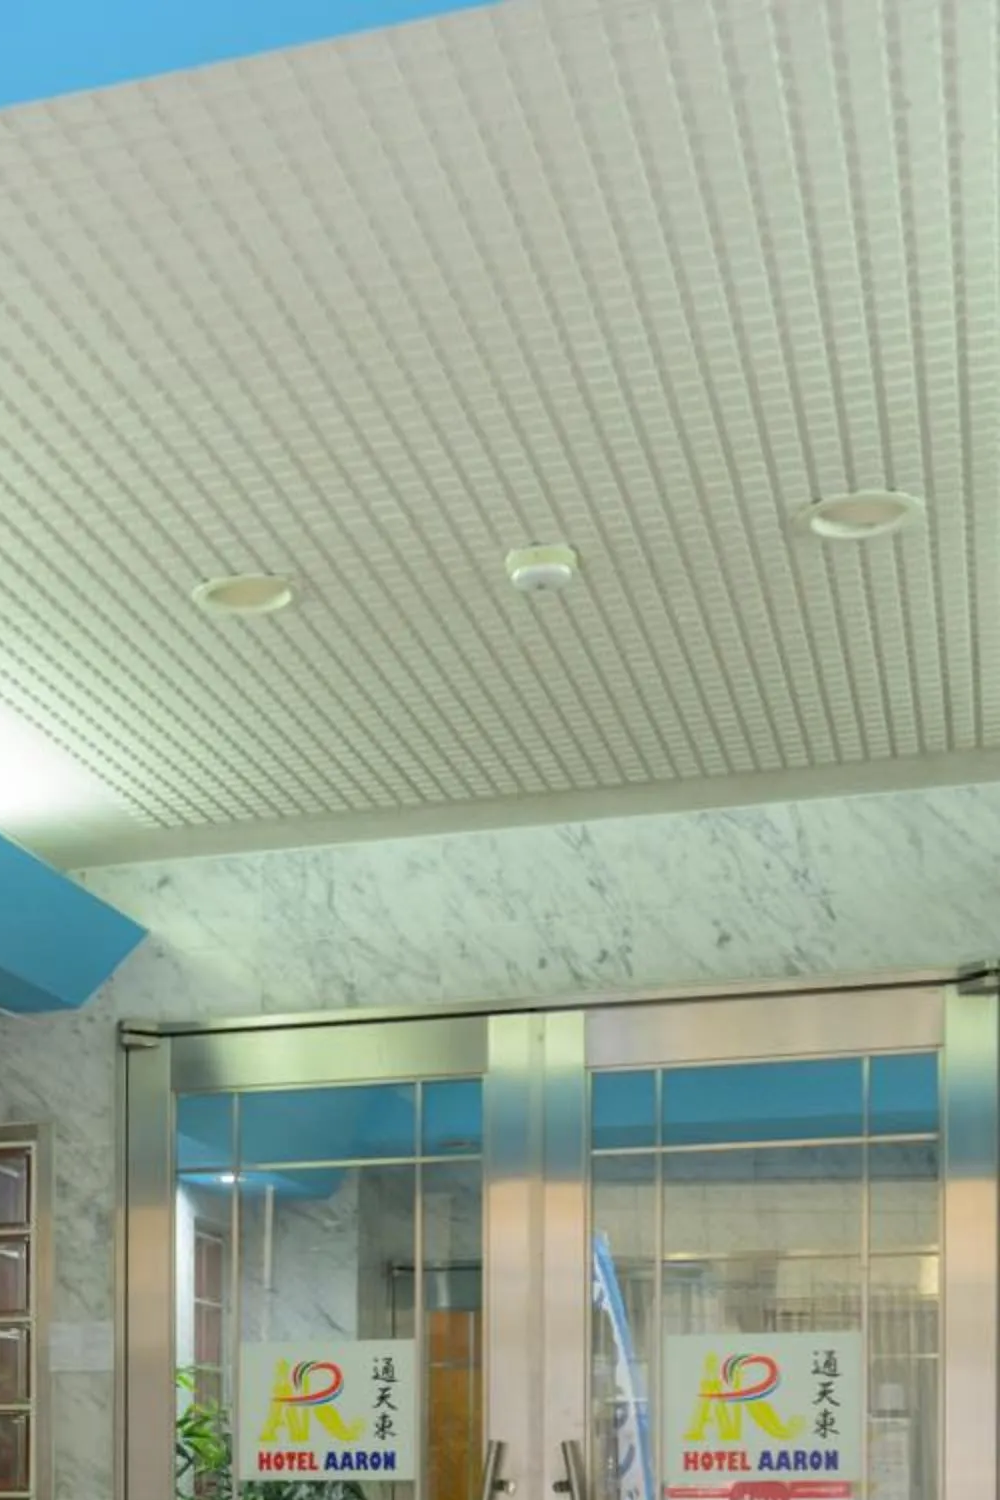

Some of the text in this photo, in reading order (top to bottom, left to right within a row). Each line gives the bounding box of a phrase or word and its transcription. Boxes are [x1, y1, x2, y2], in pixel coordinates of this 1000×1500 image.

[258, 1451, 396, 1471] HOTEL AARON
[683, 1450, 839, 1471] HOTEL AARON
